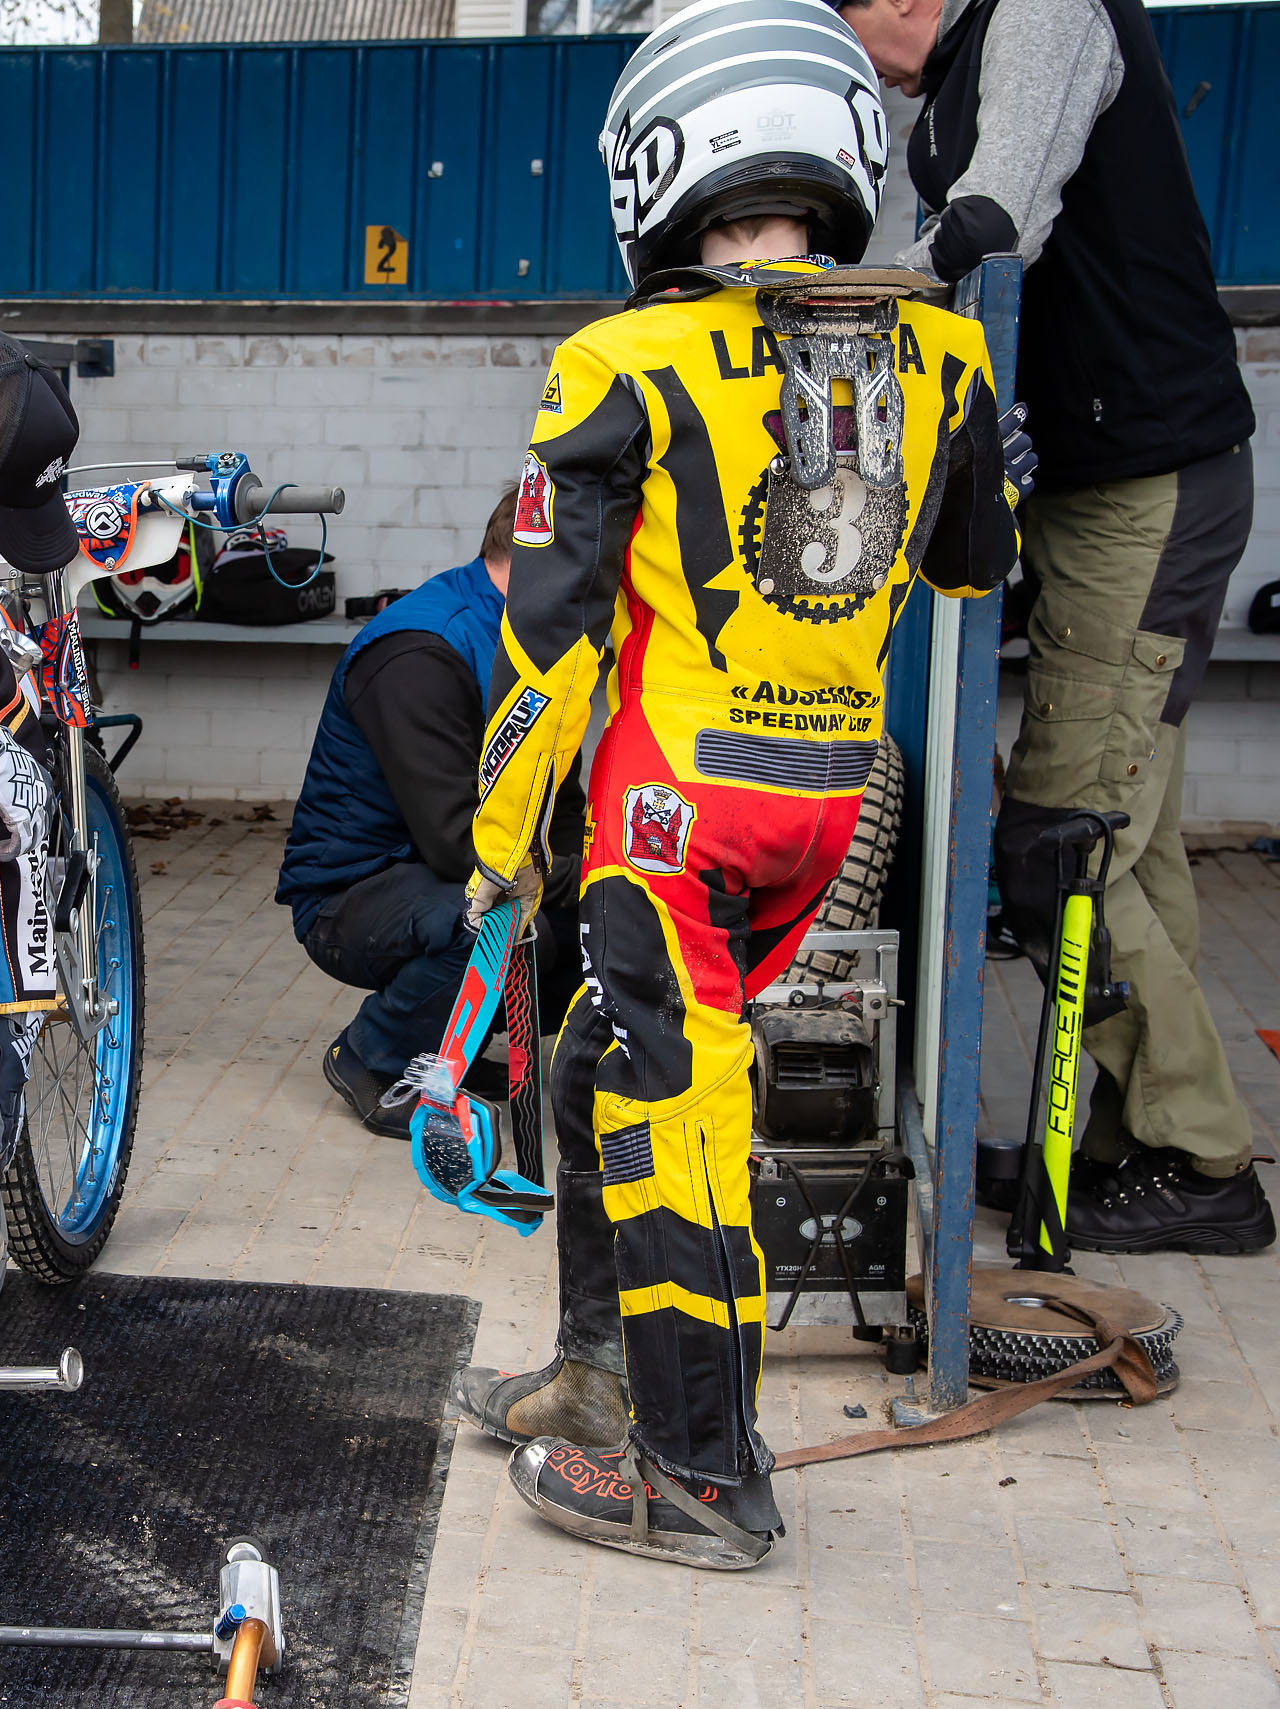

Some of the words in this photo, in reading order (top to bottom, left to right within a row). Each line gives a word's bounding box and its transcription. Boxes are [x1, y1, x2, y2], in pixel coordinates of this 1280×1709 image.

[377, 227, 397, 272] 2
[801, 467, 867, 582] 3
[729, 707, 847, 733] SPEEDWAY
[1048, 1004, 1076, 1137] FORCE
